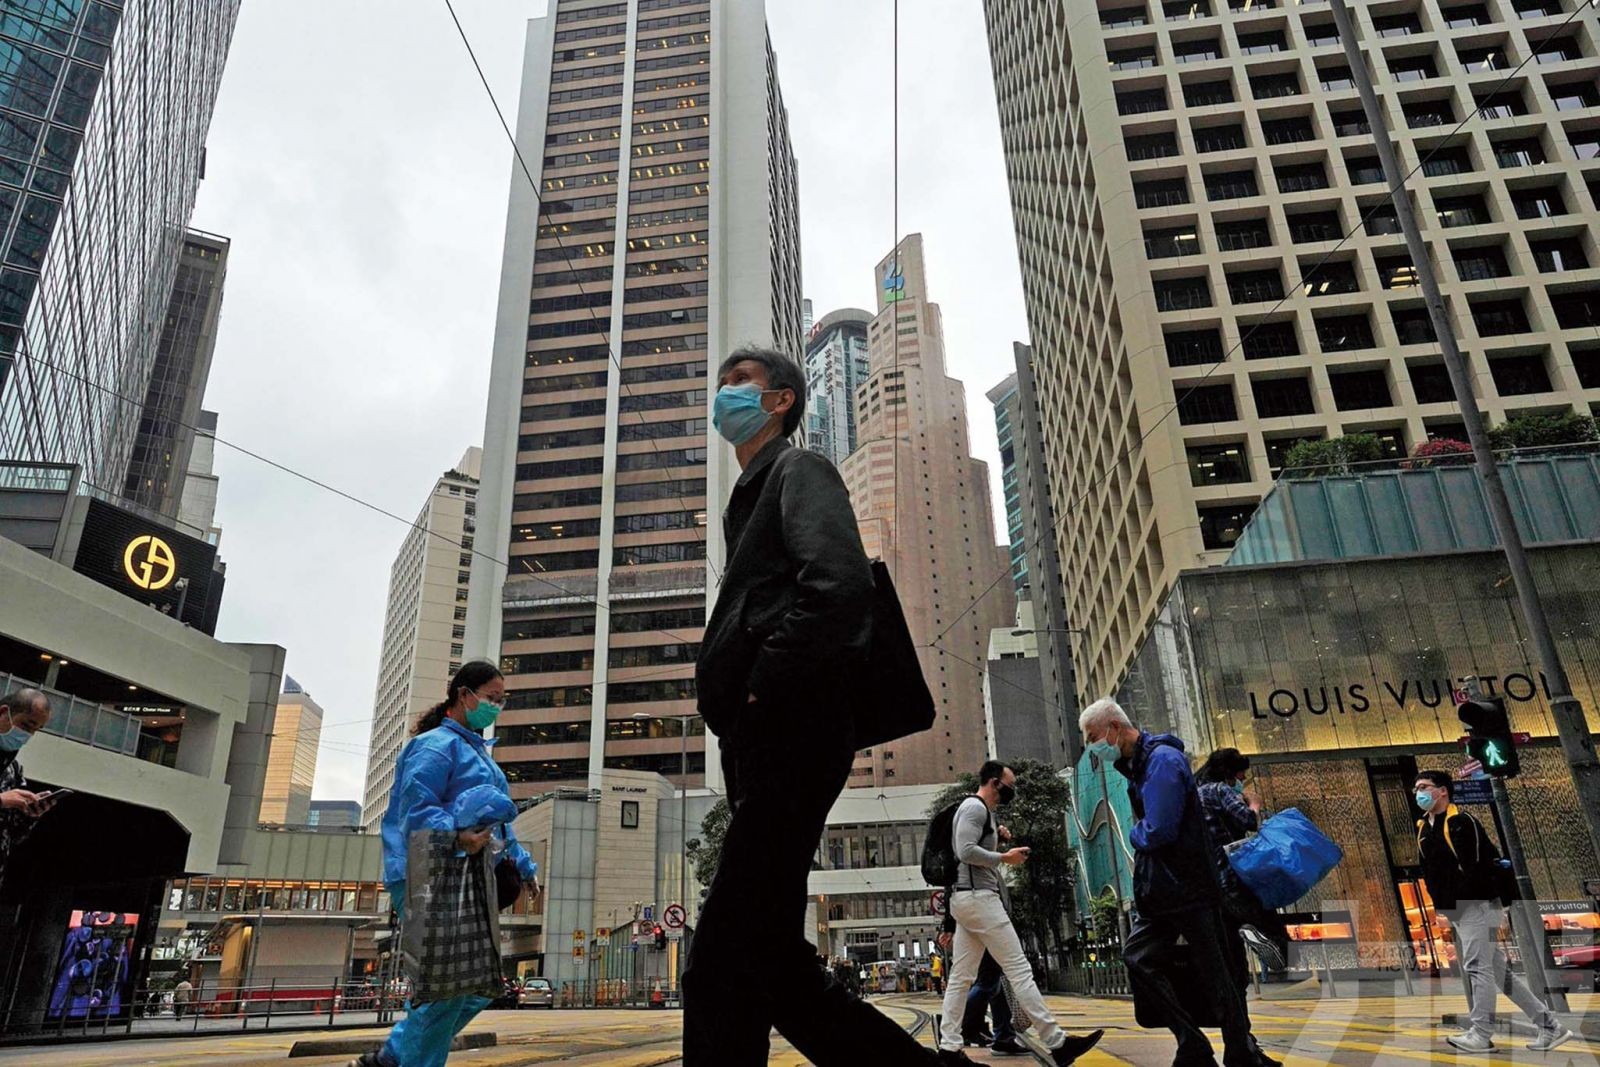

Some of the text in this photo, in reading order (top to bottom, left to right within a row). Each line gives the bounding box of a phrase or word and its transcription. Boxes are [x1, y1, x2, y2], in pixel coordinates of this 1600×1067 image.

[1250, 671, 1552, 719] LOUIS VUITO
[1556, 902, 1589, 910] VUITTON
